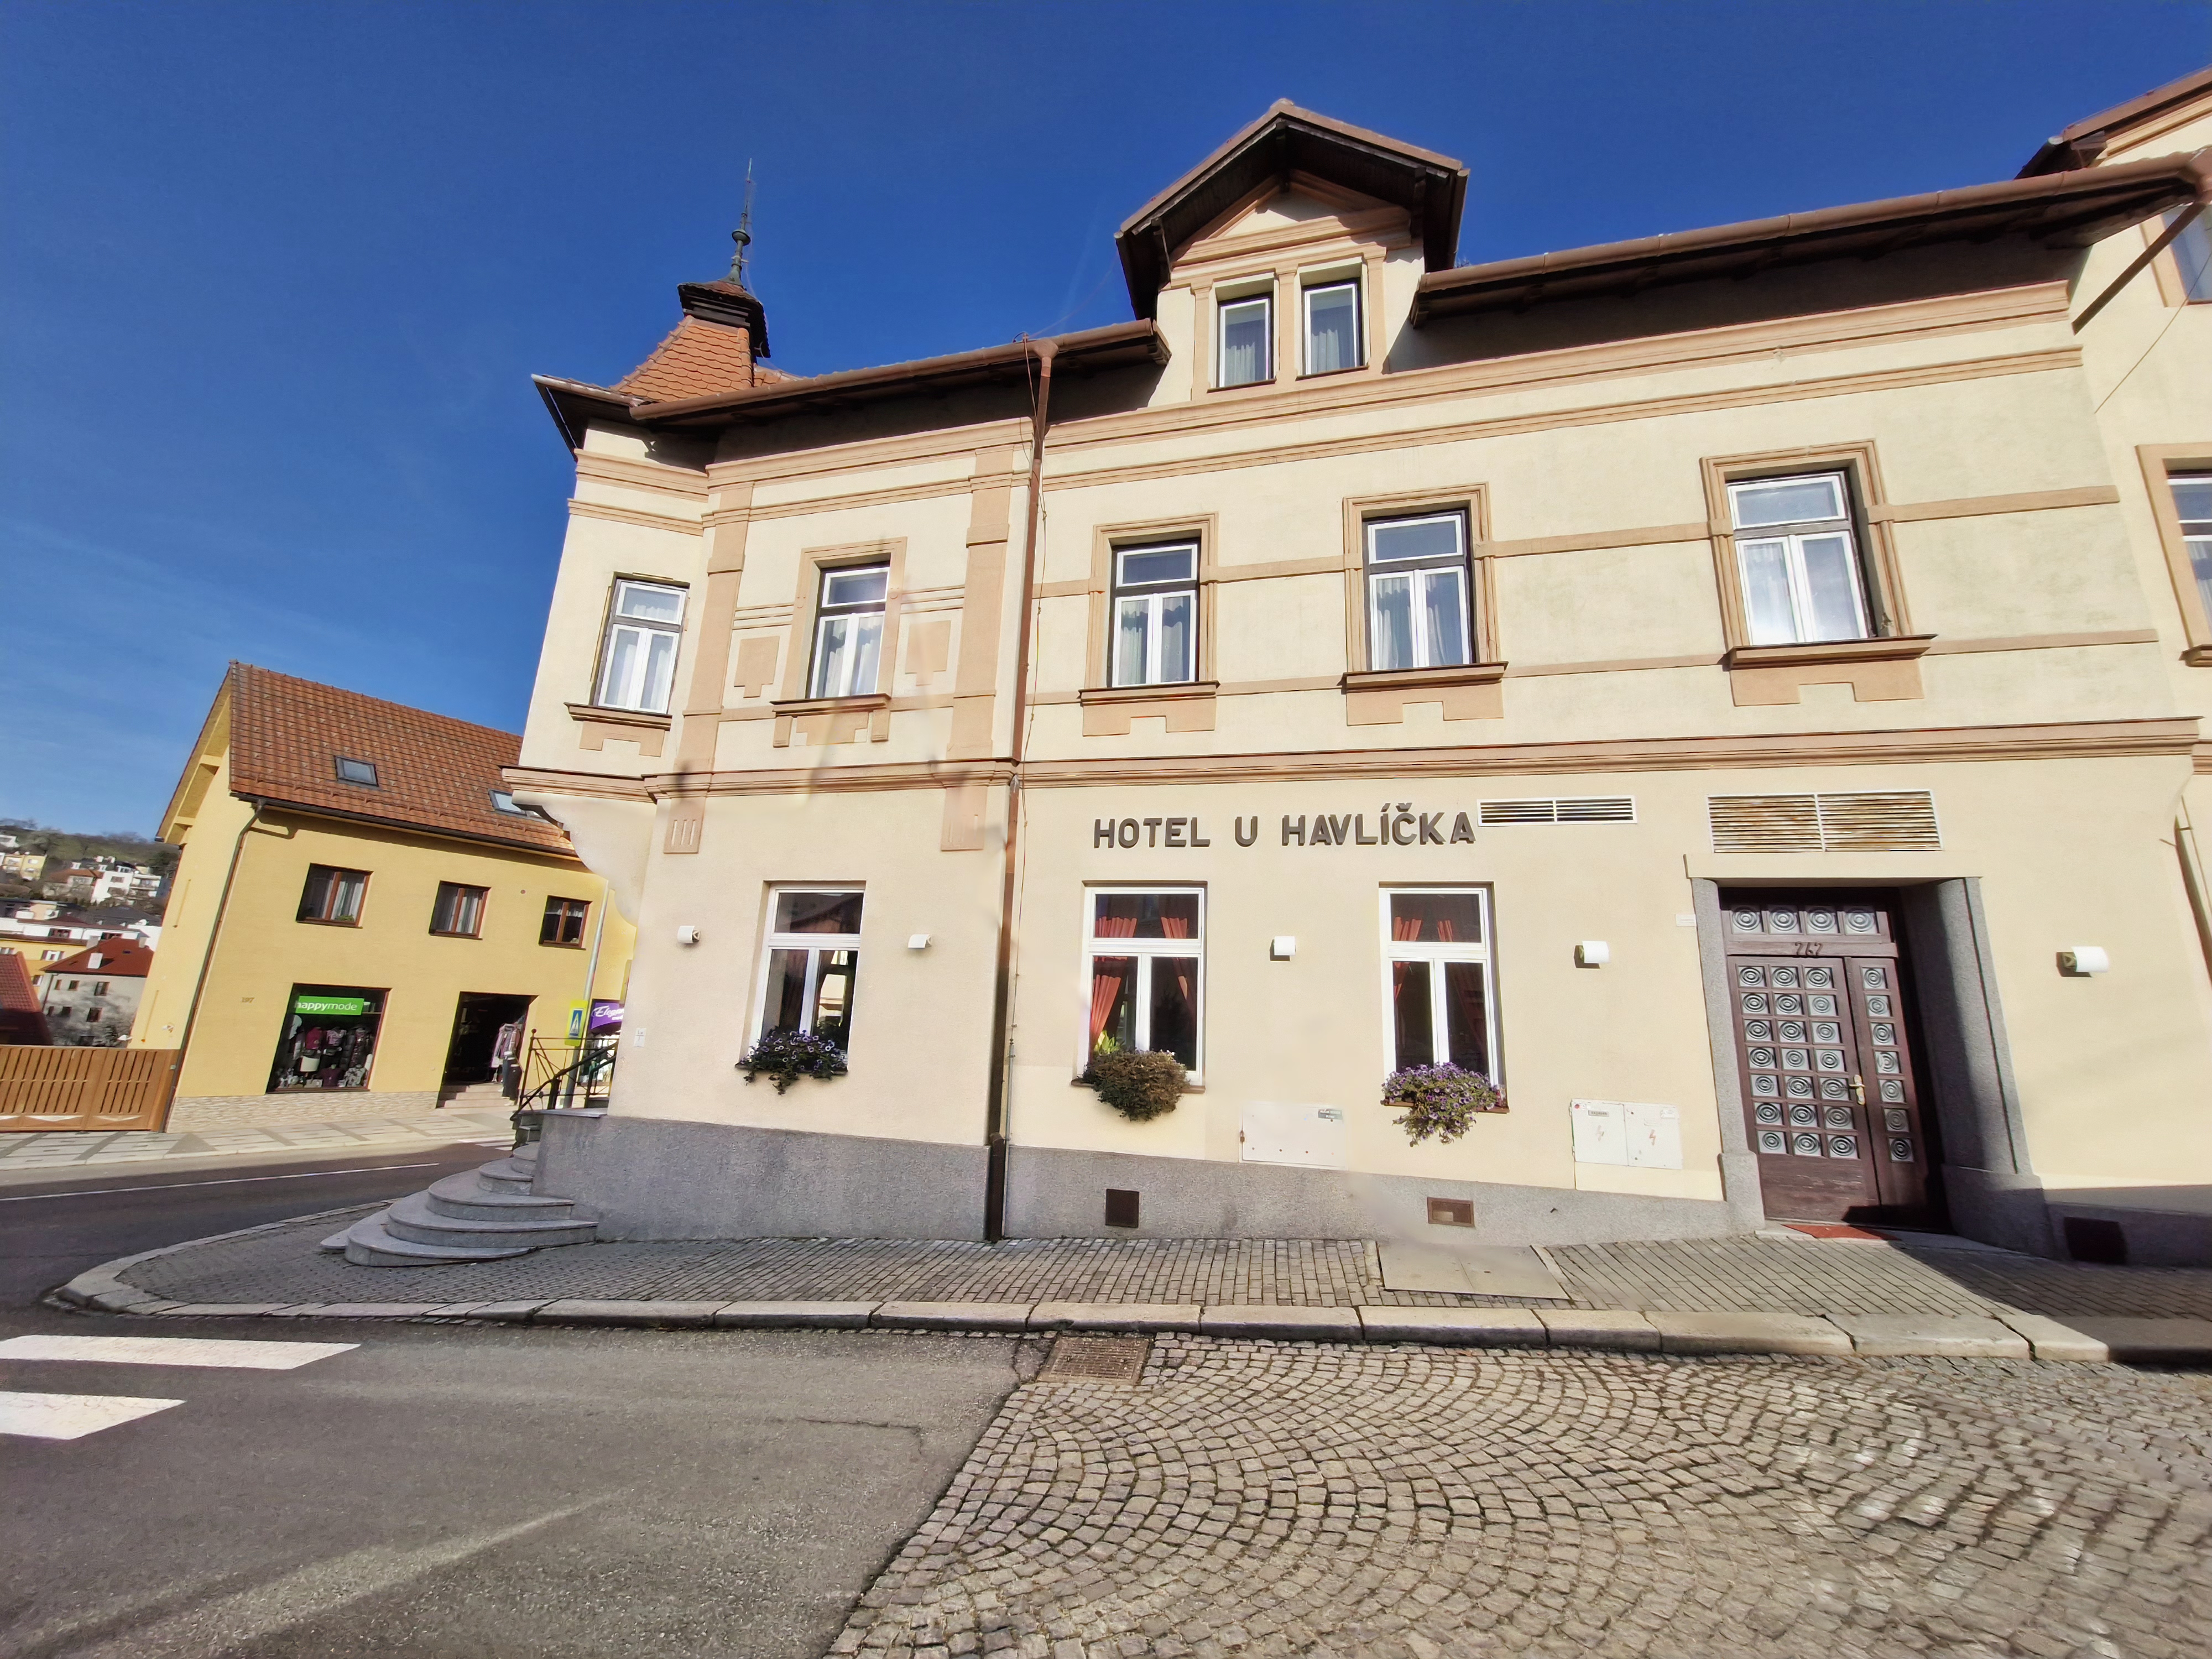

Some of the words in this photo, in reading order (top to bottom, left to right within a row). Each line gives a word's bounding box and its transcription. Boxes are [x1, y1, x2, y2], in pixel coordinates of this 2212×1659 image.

[1094, 817, 1211, 848] HOTEL
[1235, 816, 1258, 847] U
[1282, 802, 1476, 846] HAVLÍČKA
